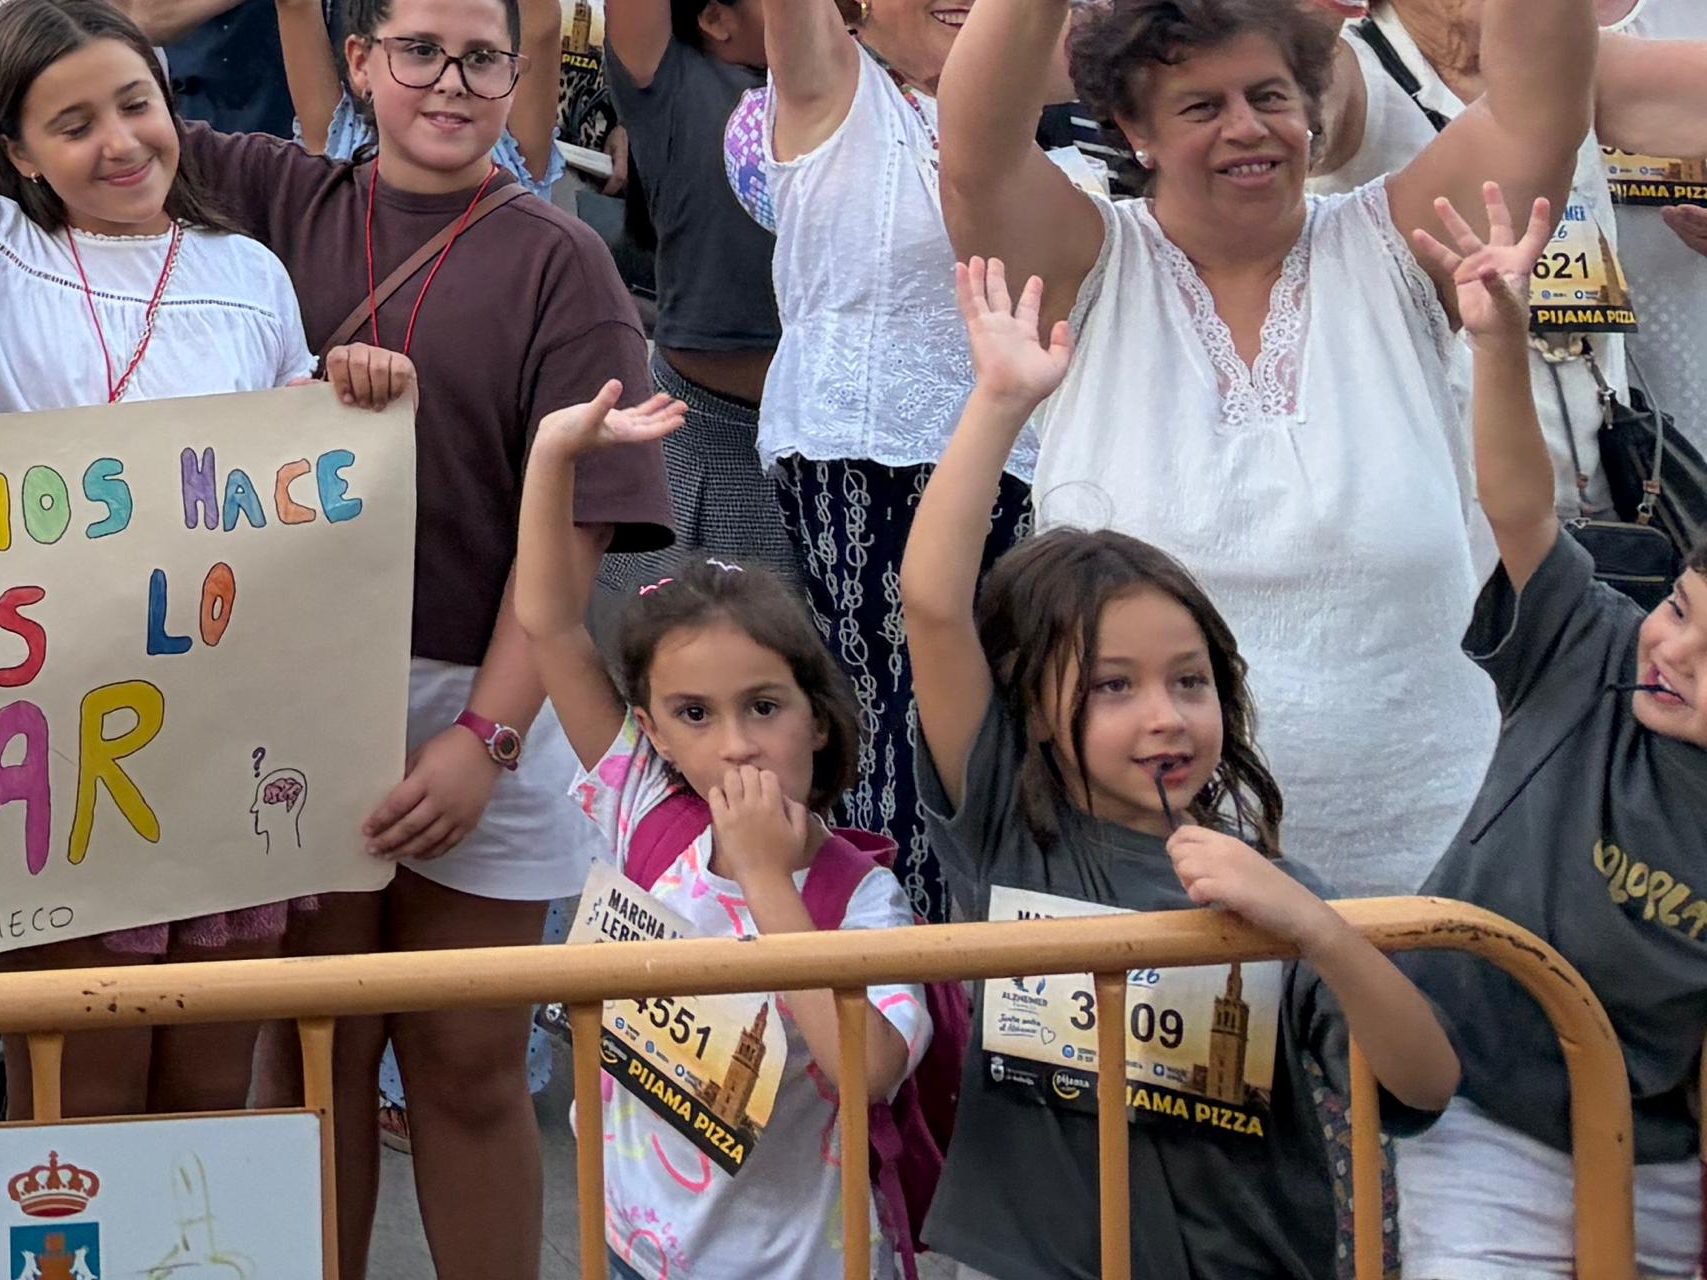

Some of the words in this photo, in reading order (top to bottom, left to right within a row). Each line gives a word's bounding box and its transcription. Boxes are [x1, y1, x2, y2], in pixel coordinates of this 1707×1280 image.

[561, 53, 598, 70] PIZZA
[1607, 182, 1668, 199] PIJAMA
[1532, 251, 1590, 280] 621
[1537, 309, 1604, 325] PIJAMA
[180, 444, 366, 536] HACE
[142, 558, 239, 660] LO
[607, 888, 665, 941] MARCHA
[1069, 990, 1185, 1050] 309
[628, 1059, 692, 1122] PIJAMA
[694, 1111, 745, 1165] PIZZA
[1195, 1101, 1264, 1138] PIZZA
